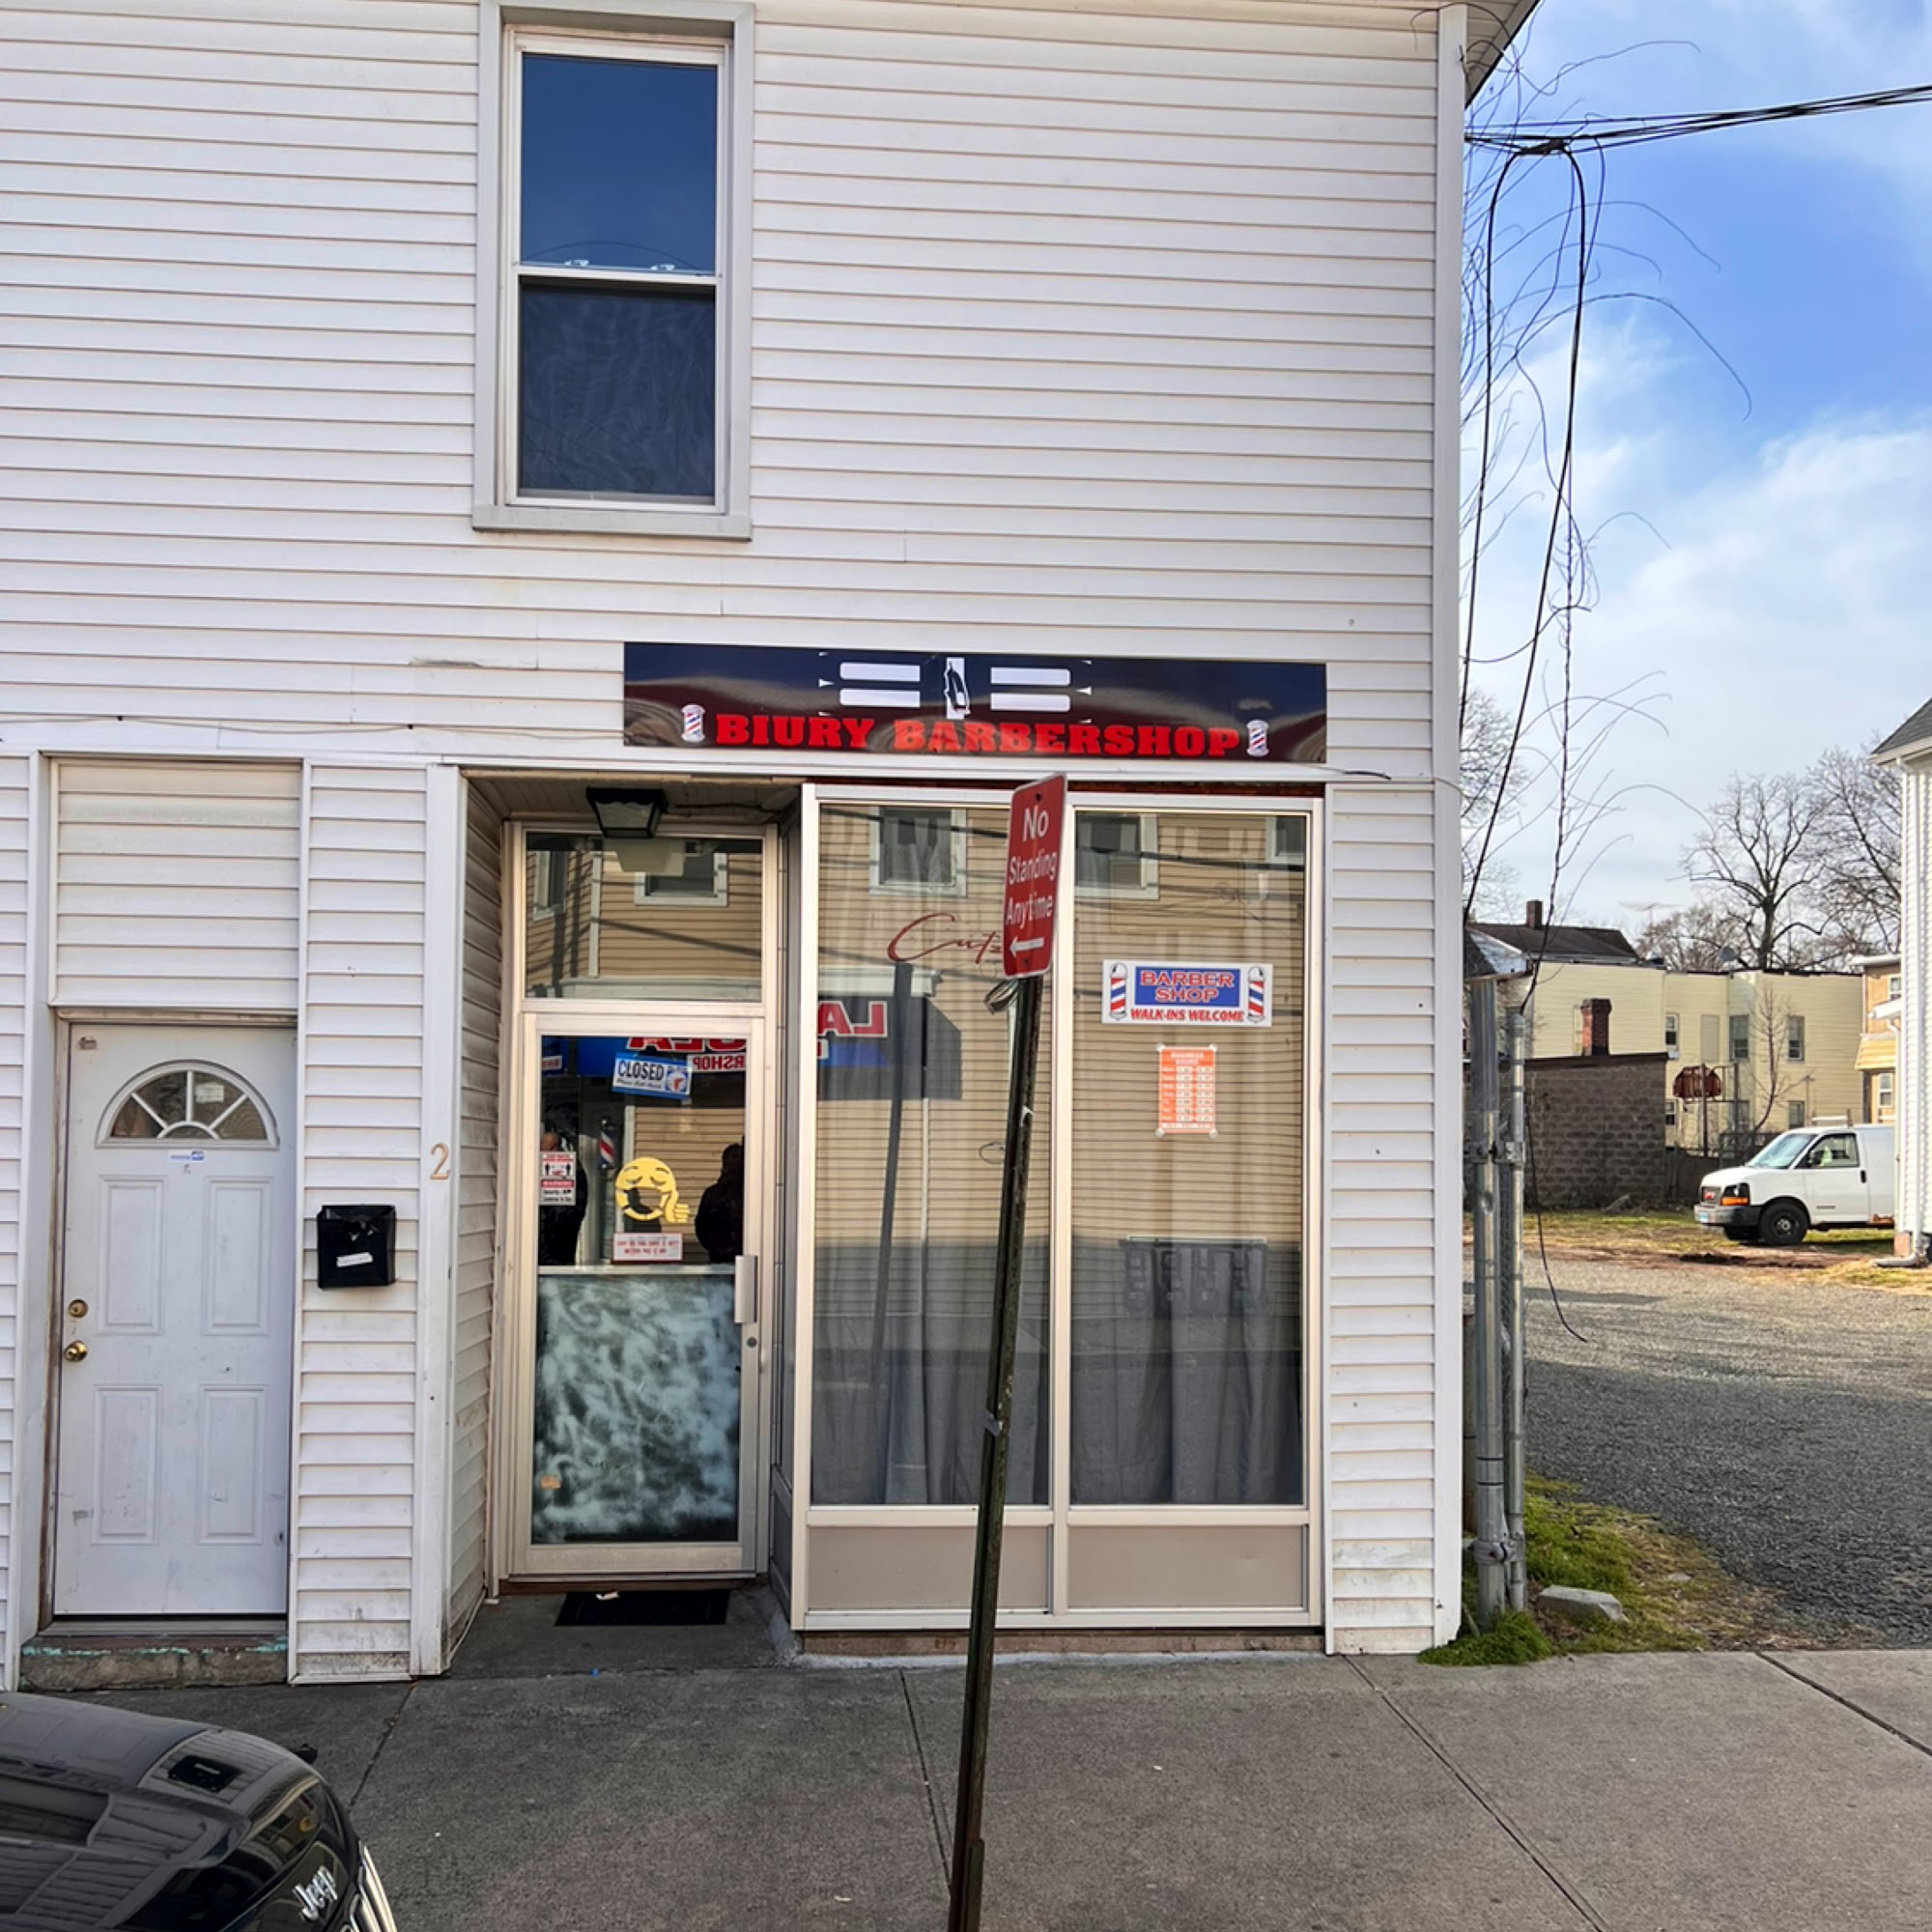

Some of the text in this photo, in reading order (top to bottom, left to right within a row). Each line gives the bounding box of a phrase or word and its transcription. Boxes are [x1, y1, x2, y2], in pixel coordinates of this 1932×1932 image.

[715, 714, 1240, 758] BIURY BARBERSHOP
[1022, 806, 1049, 841] No
[1009, 847, 1058, 884] Standing
[1006, 892, 1053, 928] Anytime
[1140, 970, 1235, 987] BARBER
[1154, 987, 1219, 1003] SHOP
[1130, 1009, 1245, 1022] WALK-INS WELCOME
[617, 1060, 665, 1082] CLOSED
[429, 1143, 451, 1180] 2
[294, 1864, 338, 1921] Jeep
